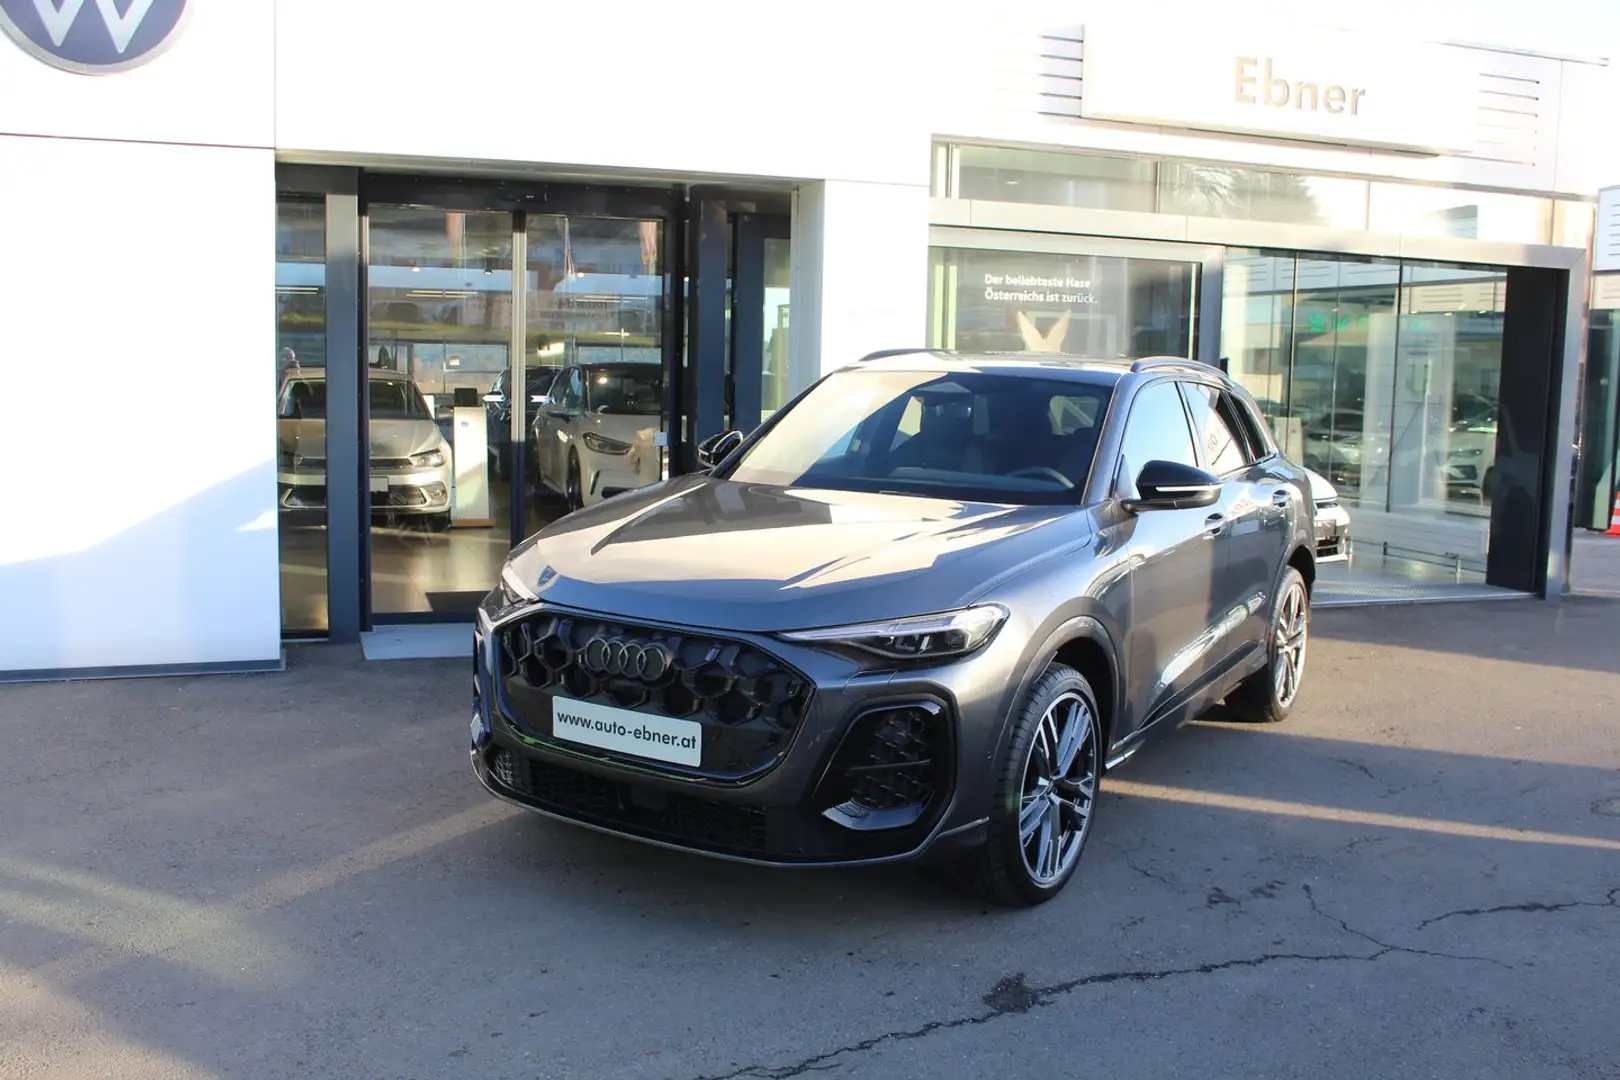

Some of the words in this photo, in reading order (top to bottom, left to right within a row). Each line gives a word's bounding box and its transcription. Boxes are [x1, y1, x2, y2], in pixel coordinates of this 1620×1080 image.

[1235, 56, 1366, 116] Ebner
[984, 273, 1004, 285] Der
[1005, 274, 1063, 288] beliebteste
[1065, 277, 1091, 289] Hase
[984, 286, 1044, 302] Österreichs
[1046, 291, 1060, 302] ist
[1062, 292, 1098, 304] zurück.
[556, 711, 697, 750] www.auto-ebner.at
